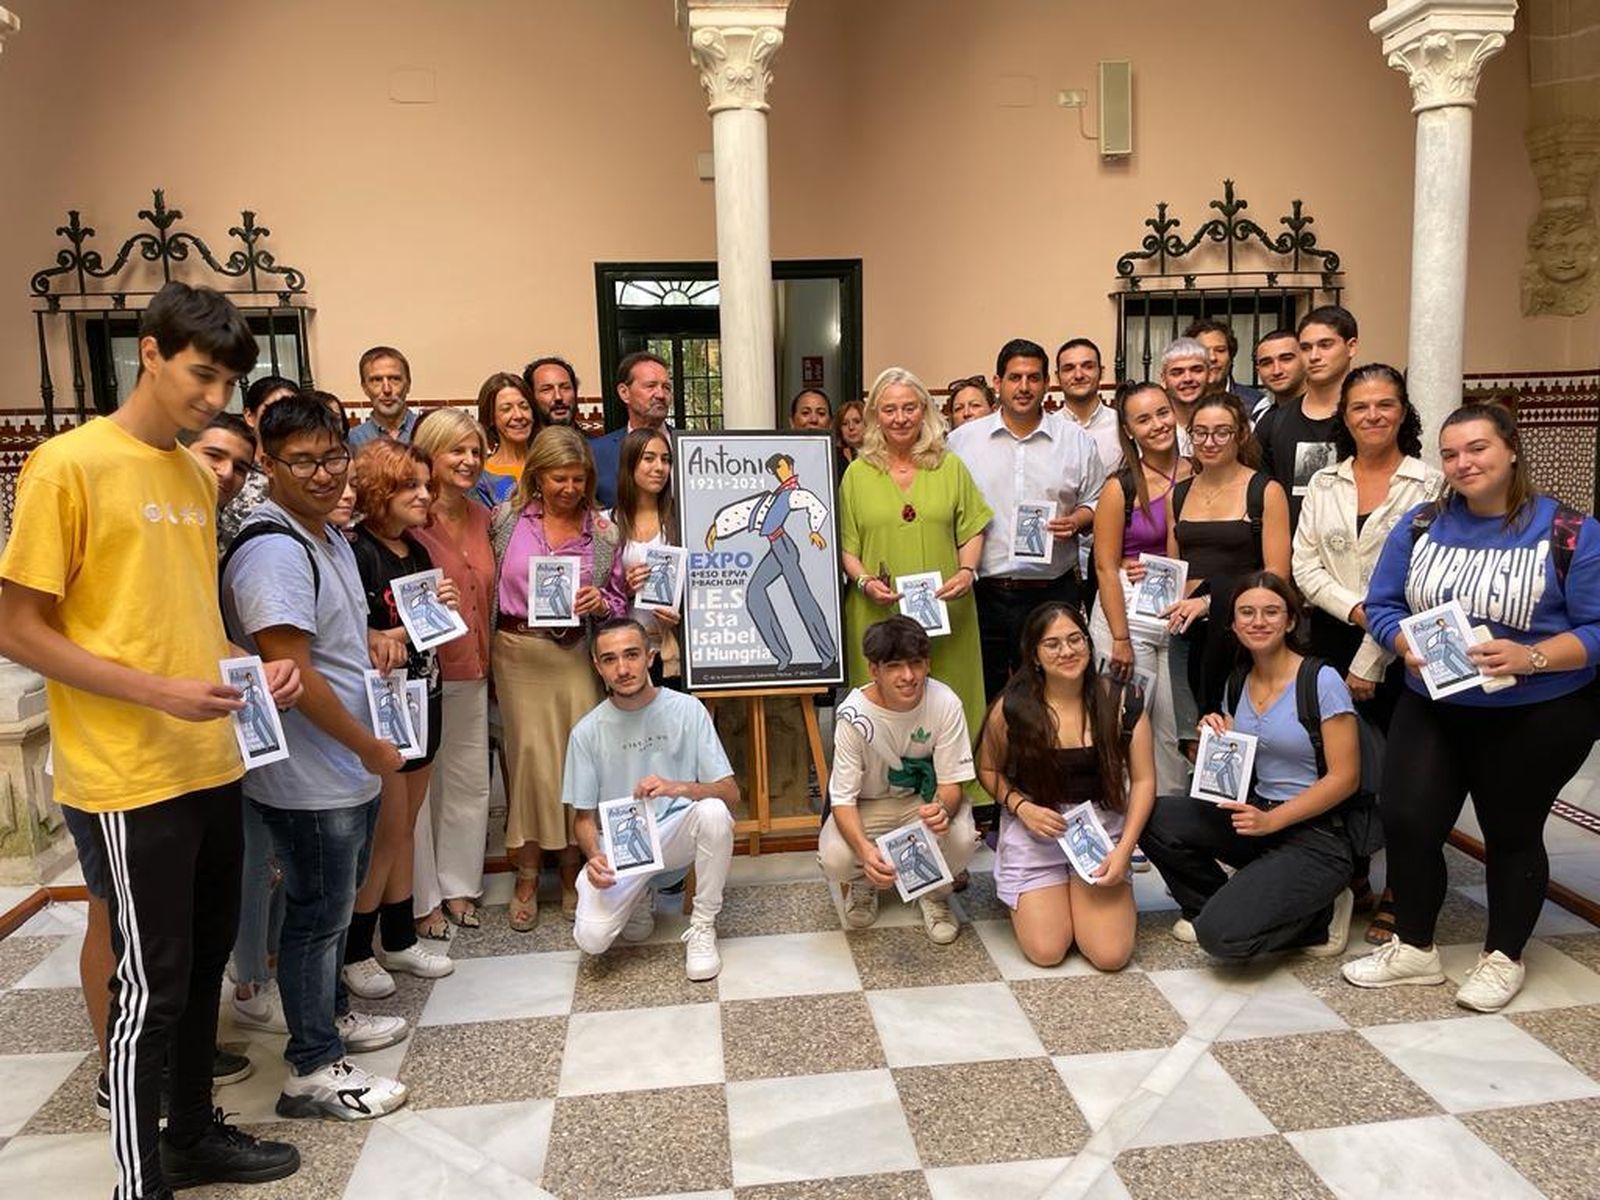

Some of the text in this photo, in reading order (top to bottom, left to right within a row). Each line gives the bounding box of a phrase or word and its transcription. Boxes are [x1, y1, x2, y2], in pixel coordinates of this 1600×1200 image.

[690, 477, 766, 490] 1921-2021
[690, 551, 754, 570] EXPO
[704, 610, 738, 628] Sta
[692, 626, 756, 646] Isabel
